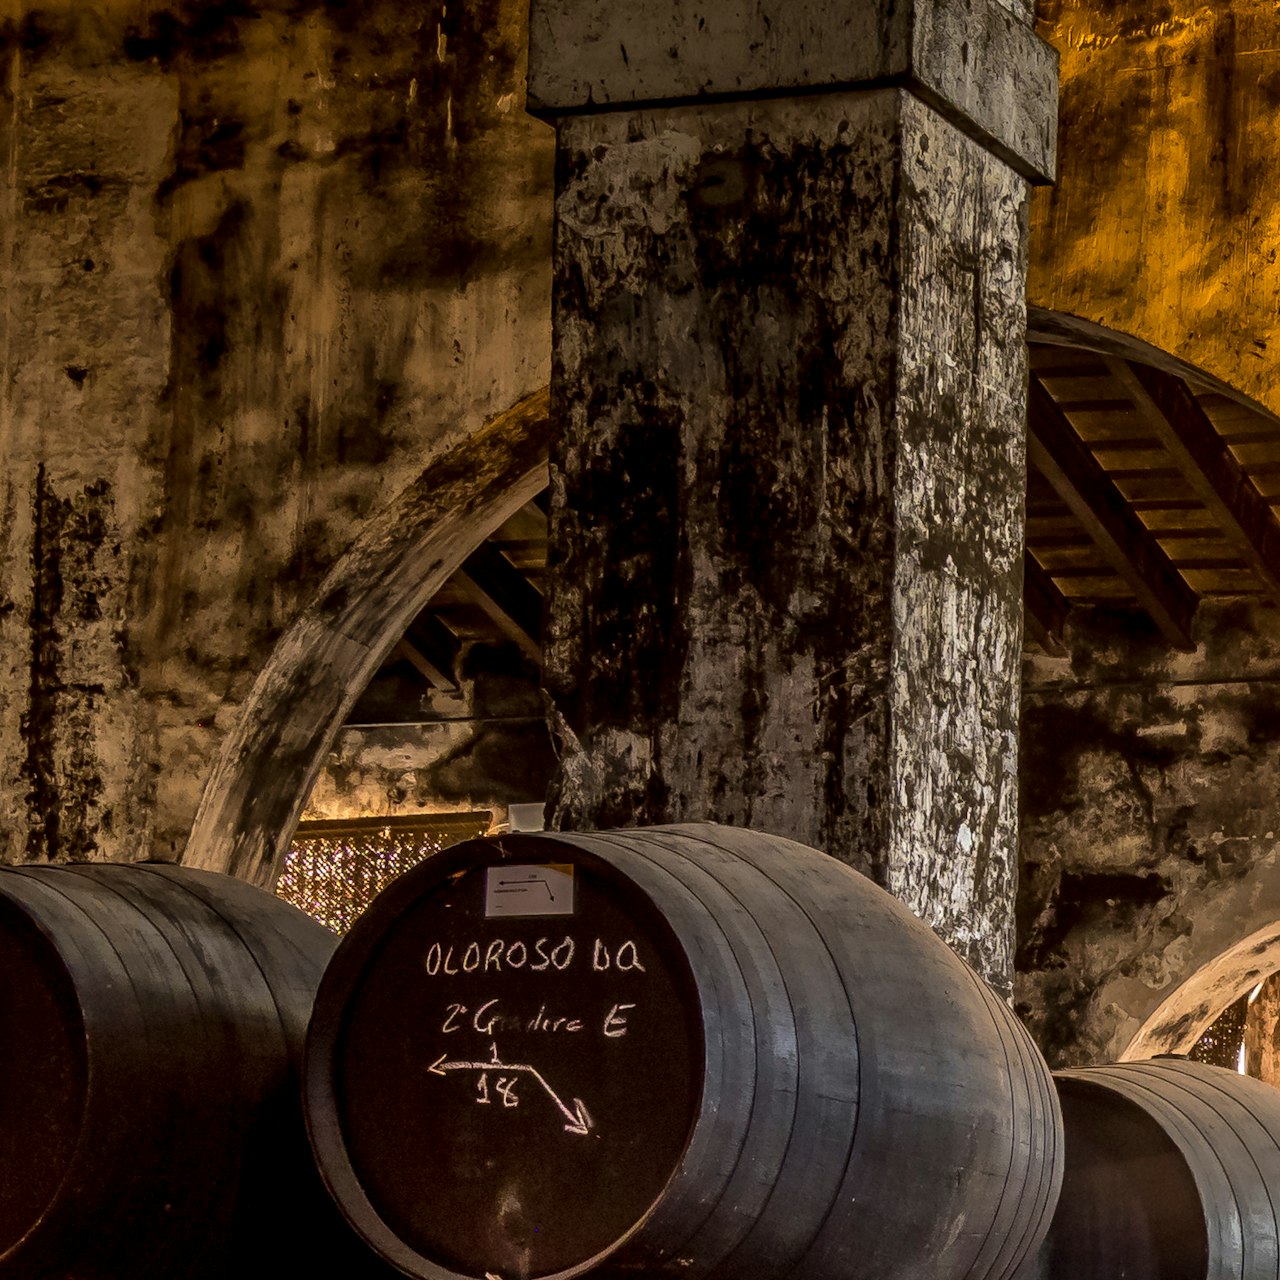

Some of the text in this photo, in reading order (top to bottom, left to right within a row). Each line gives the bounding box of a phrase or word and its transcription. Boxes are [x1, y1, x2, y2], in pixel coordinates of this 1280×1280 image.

[427, 936, 574, 975] OLOROSO
[603, 1003, 636, 1037] E
[476, 1072, 519, 1107] 18
